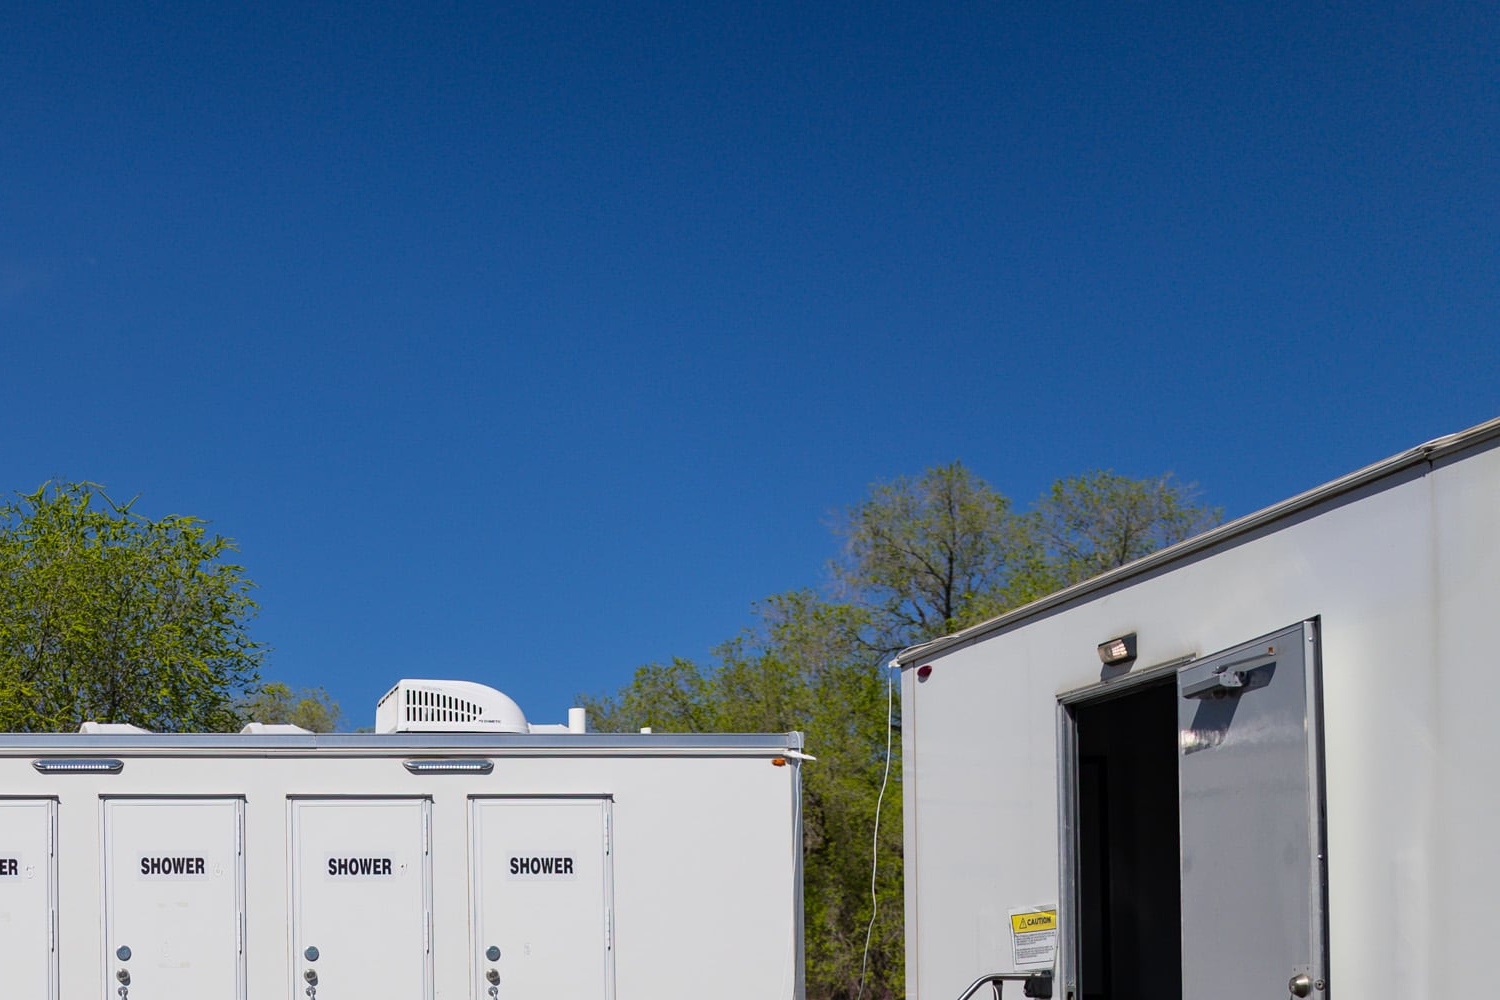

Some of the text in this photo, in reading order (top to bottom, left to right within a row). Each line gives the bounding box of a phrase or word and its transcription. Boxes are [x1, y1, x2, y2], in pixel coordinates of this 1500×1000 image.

[140, 857, 205, 875] SHOWER
[328, 857, 392, 876] SHOWER
[510, 857, 574, 875] SHOWER
[1027, 916, 1052, 926] CAUTION
